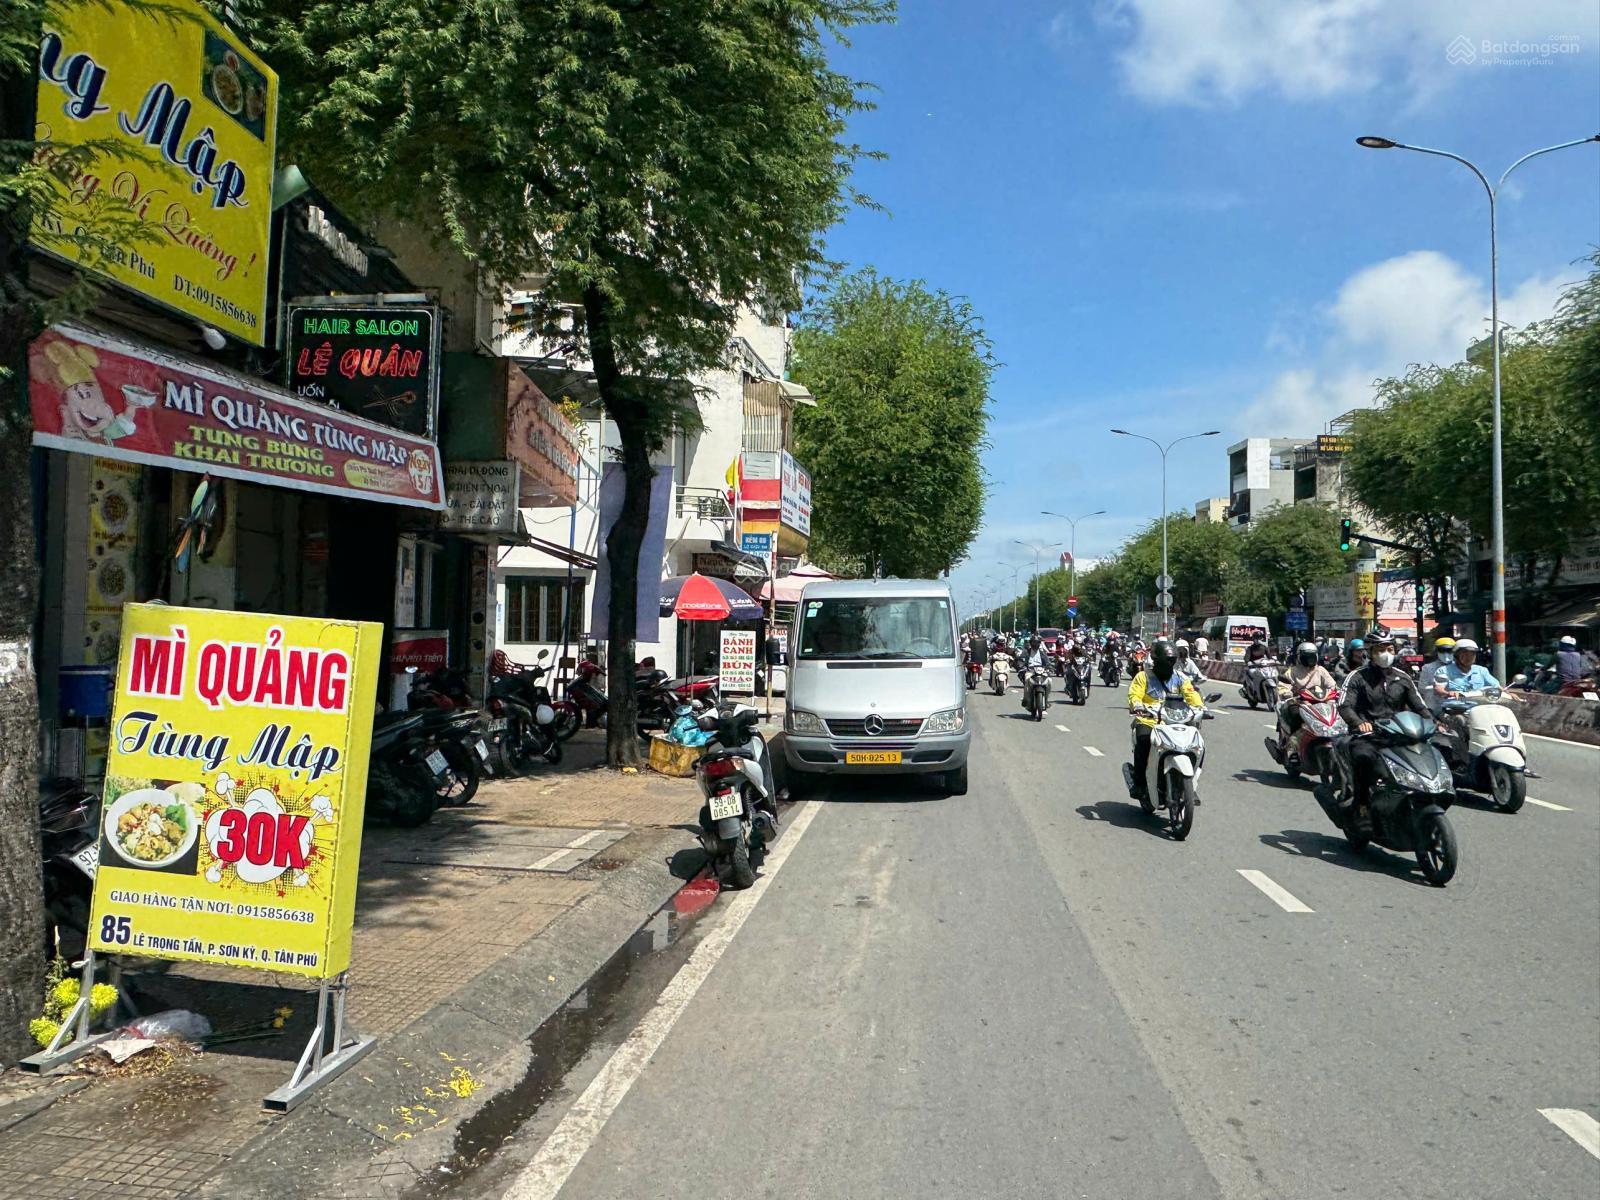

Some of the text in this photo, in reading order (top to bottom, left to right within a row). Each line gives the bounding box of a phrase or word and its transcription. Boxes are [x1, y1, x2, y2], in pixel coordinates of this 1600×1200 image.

[118, 82, 249, 210] Mập
[130, 252, 155, 280] Phú
[304, 318, 418, 336] HAIR SALON
[297, 341, 423, 379] LÊ QUÂN
[297, 382, 325, 397] UỐN
[165, 381, 408, 468] MÌ QUẢNG TÙNG MẬP
[174, 441, 241, 465] KHAI
[723, 636, 753, 645] BÁNH
[723, 647, 753, 655] CANH
[130, 629, 348, 710] MÌ QUẢNG
[722, 660, 753, 670] BÚN
[118, 711, 343, 780] Tùng Mập
[216, 809, 310, 869] 30K
[110, 890, 314, 923] GIAO HÀNG TẬN NƠI: 0915856638
[100, 915, 131, 944] 85
[133, 932, 144, 946] LÊ
[147, 936, 179, 952] TRỌNG
[183, 937, 204, 955] TẤN,
[208, 944, 215, 955] P.
[219, 944, 239, 958] SƠN
[262, 949, 271, 962] Q.
[274, 949, 294, 965] TÂN
[297, 952, 318, 967] PHÚ
